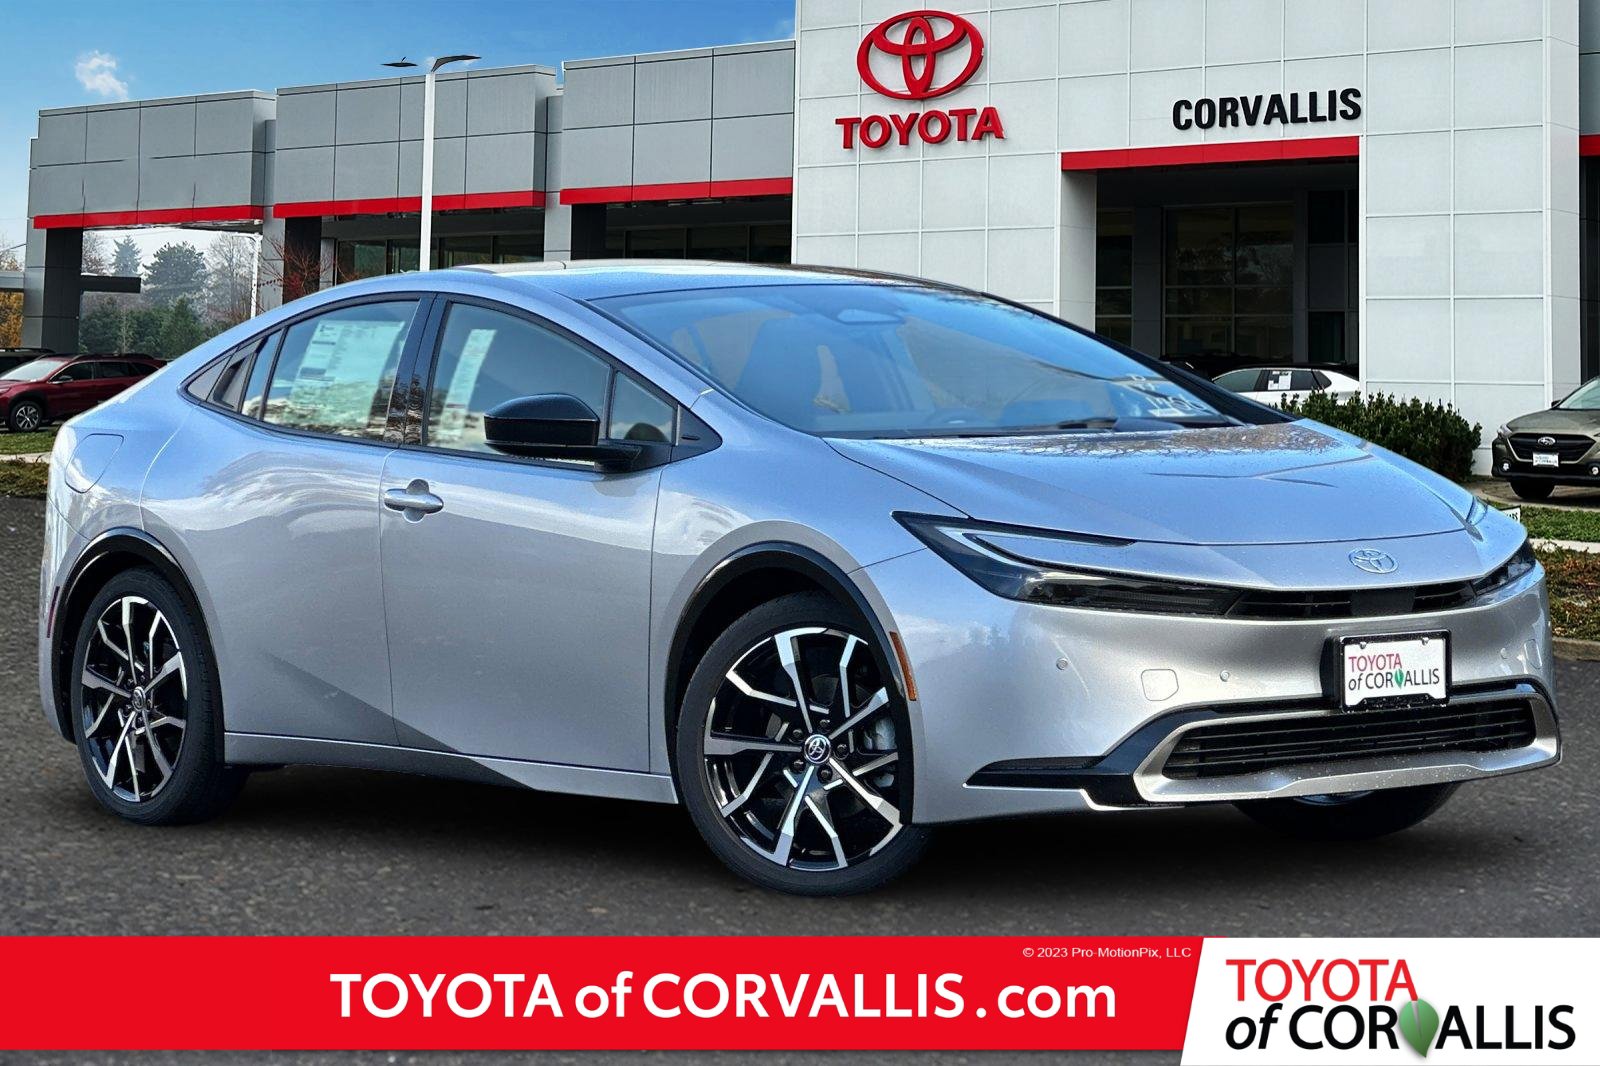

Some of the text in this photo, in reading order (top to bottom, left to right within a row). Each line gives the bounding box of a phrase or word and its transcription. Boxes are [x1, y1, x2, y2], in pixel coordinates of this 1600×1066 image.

[1172, 87, 1362, 131] CORVALLIS
[836, 106, 1005, 149] TOYOTA
[1348, 652, 1403, 673] TOYOTA
[1348, 672, 1364, 691] of
